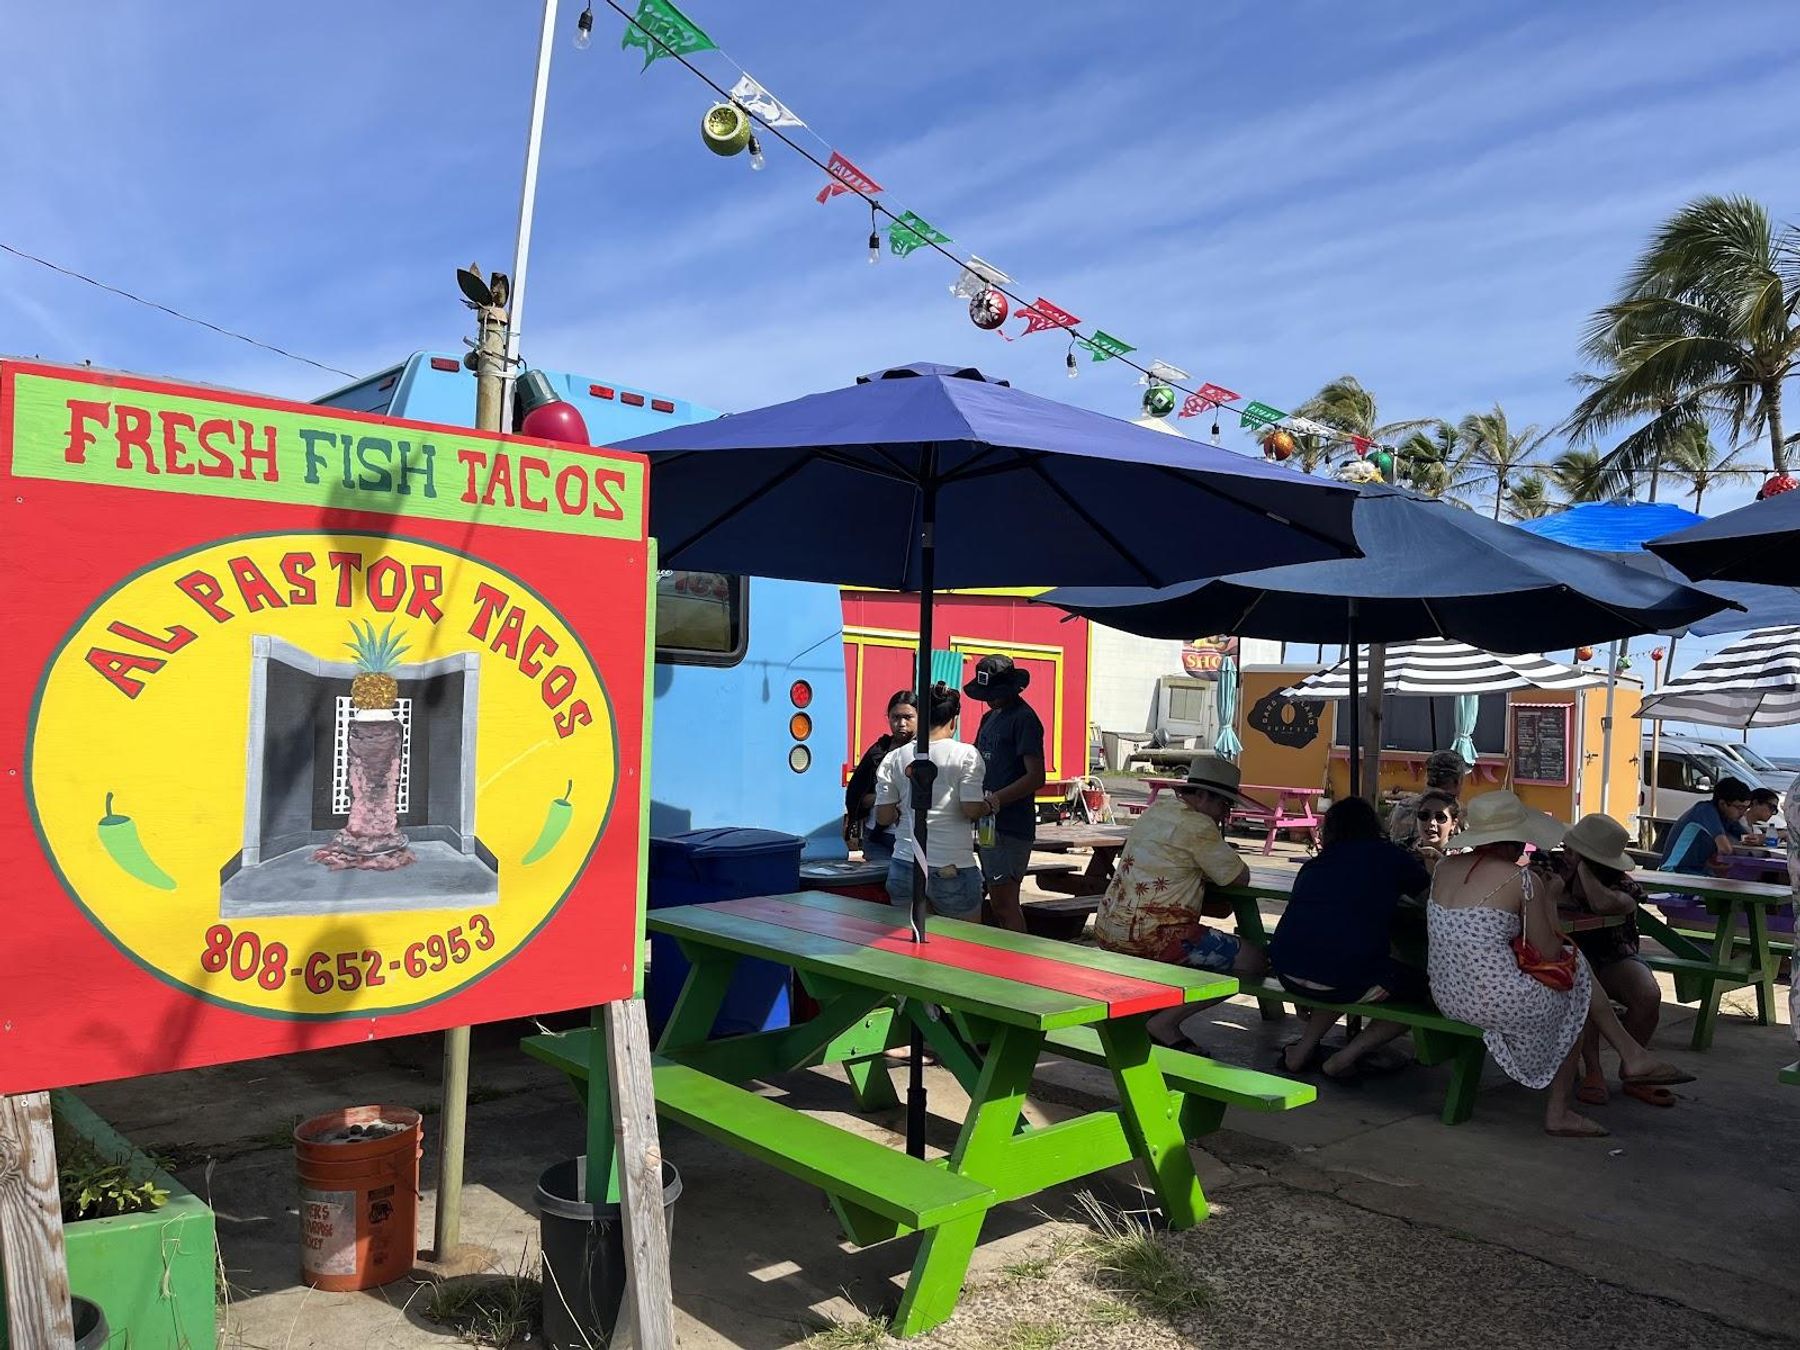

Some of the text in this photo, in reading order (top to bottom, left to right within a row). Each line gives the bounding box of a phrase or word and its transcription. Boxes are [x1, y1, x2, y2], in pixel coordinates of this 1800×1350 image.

[65, 399, 626, 521] FRESH FISH TACOS
[85, 551, 593, 739] AL PASTOR TACOS
[1186, 654, 1223, 670] SHO
[200, 914, 496, 995] 808-652-6953
